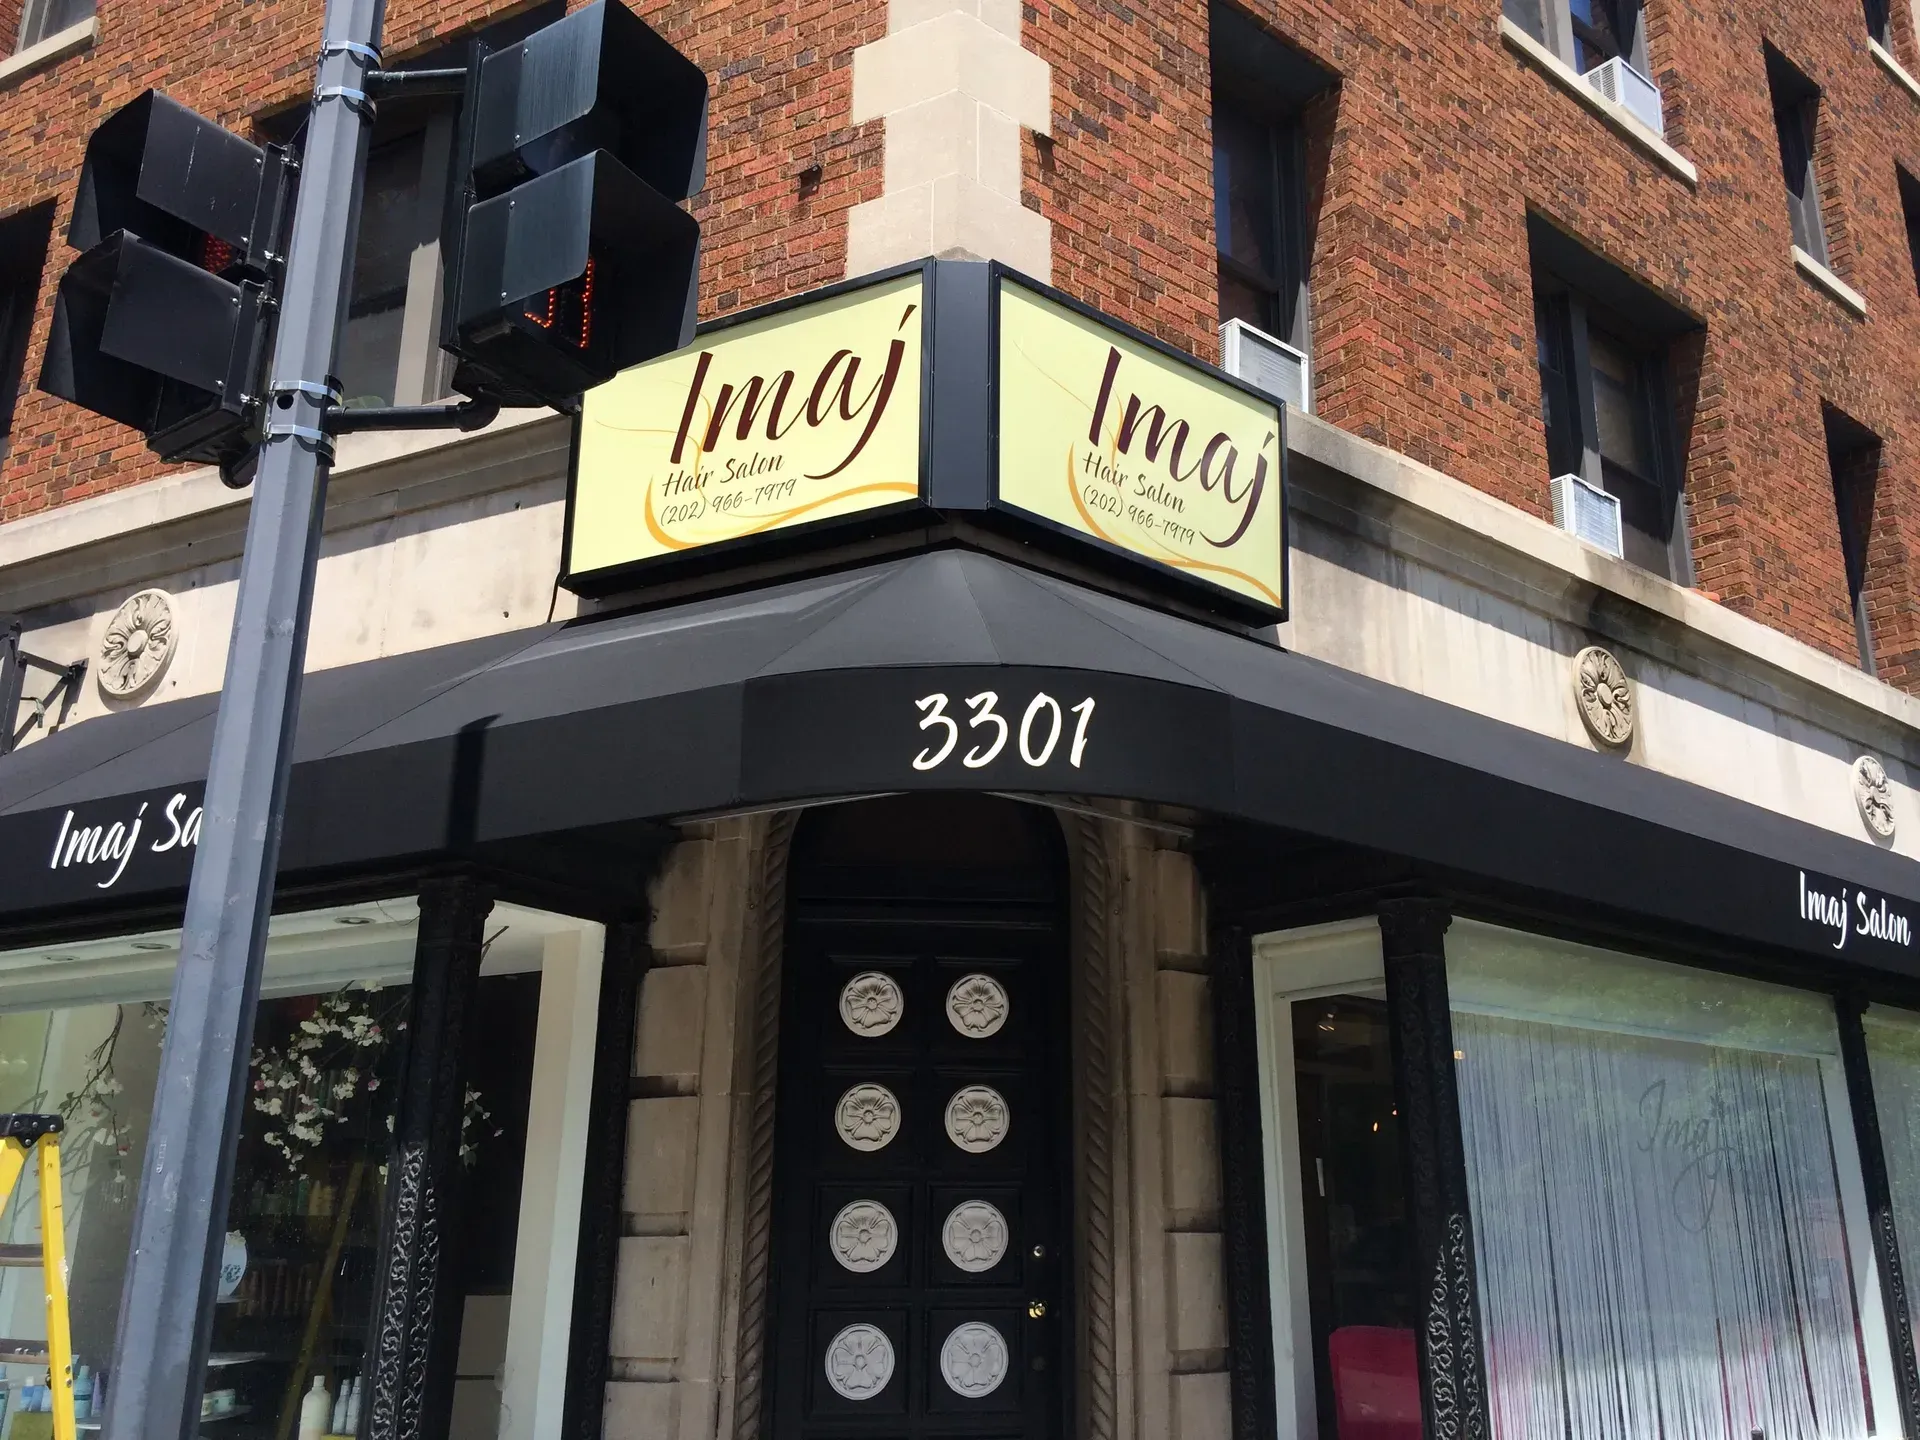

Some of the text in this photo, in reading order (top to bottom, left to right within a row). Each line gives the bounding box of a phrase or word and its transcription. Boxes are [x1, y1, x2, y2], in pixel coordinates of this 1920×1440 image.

[670, 304, 917, 480] Imaj
[662, 451, 786, 498] Hair Salon
[1082, 451, 1186, 514] Hair Salon
[1088, 346, 1275, 548] Imaj
[660, 478, 797, 527] (202) 966-7979
[1083, 484, 1196, 546] (202) 966-7979
[912, 691, 1096, 771] 3301
[51, 801, 149, 888] Imaj
[1800, 870, 1912, 950] Imaj Salon
